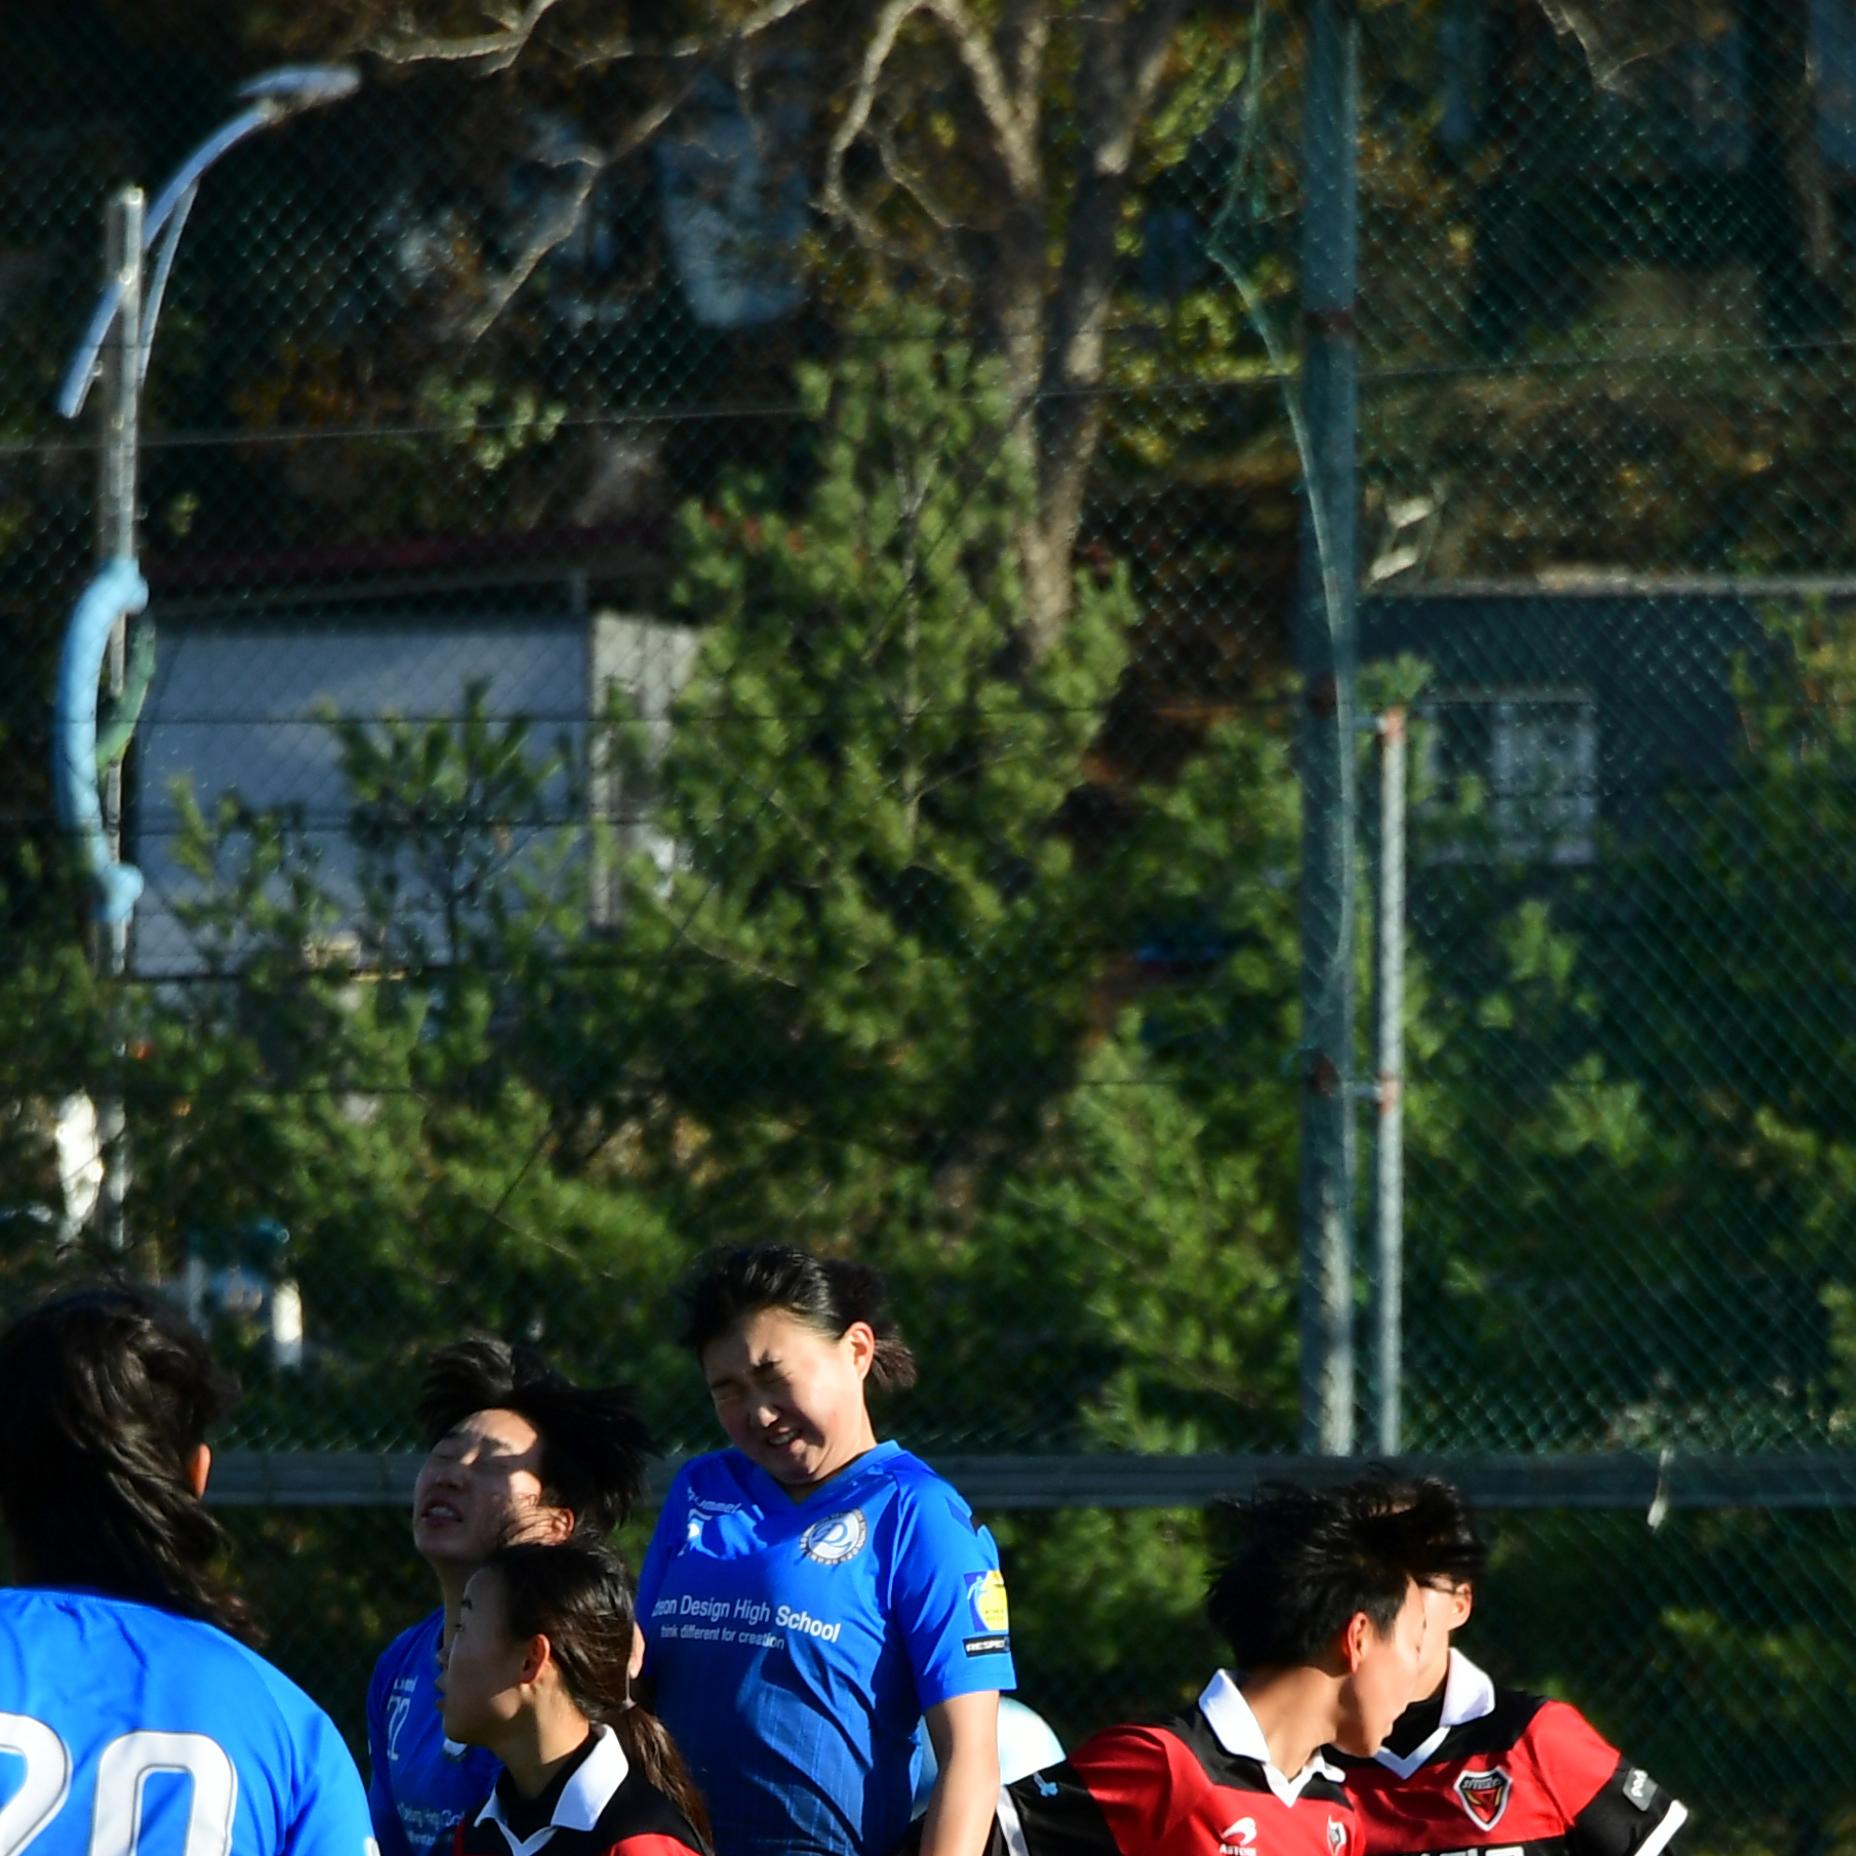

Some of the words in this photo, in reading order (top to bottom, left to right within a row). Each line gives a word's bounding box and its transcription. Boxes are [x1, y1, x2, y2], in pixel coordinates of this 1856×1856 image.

[679, 1594, 730, 1622] Design
[733, 1598, 771, 1625] High
[775, 1604, 841, 1643] School
[721, 1626, 737, 1642] for
[738, 1630, 785, 1650] creation
